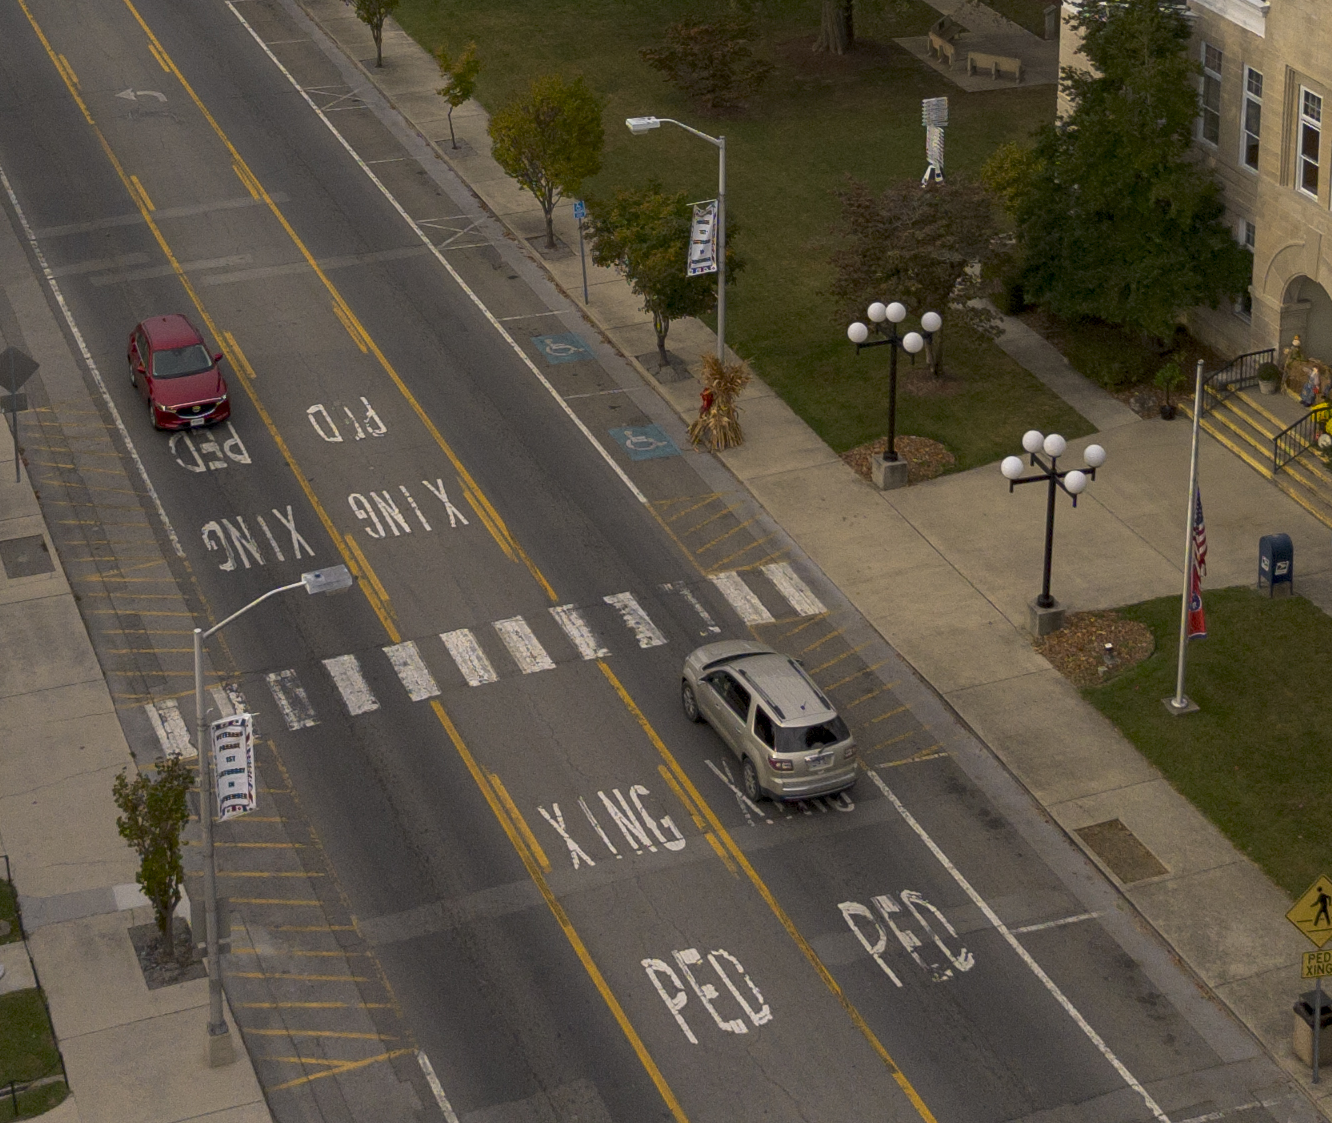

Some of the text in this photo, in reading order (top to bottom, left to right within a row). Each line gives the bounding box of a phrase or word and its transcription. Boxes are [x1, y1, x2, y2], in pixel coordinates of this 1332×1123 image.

[168, 420, 252, 473] PED
[201, 504, 316, 572] XING
[346, 478, 469, 539] XING
[216, 731, 243, 741] VETERANS
[219, 743, 240, 752] PARADE
[537, 784, 687, 870] XING
[836, 888, 976, 988] PED
[1308, 951, 1331, 964] PED
[640, 948, 773, 1045] PED
